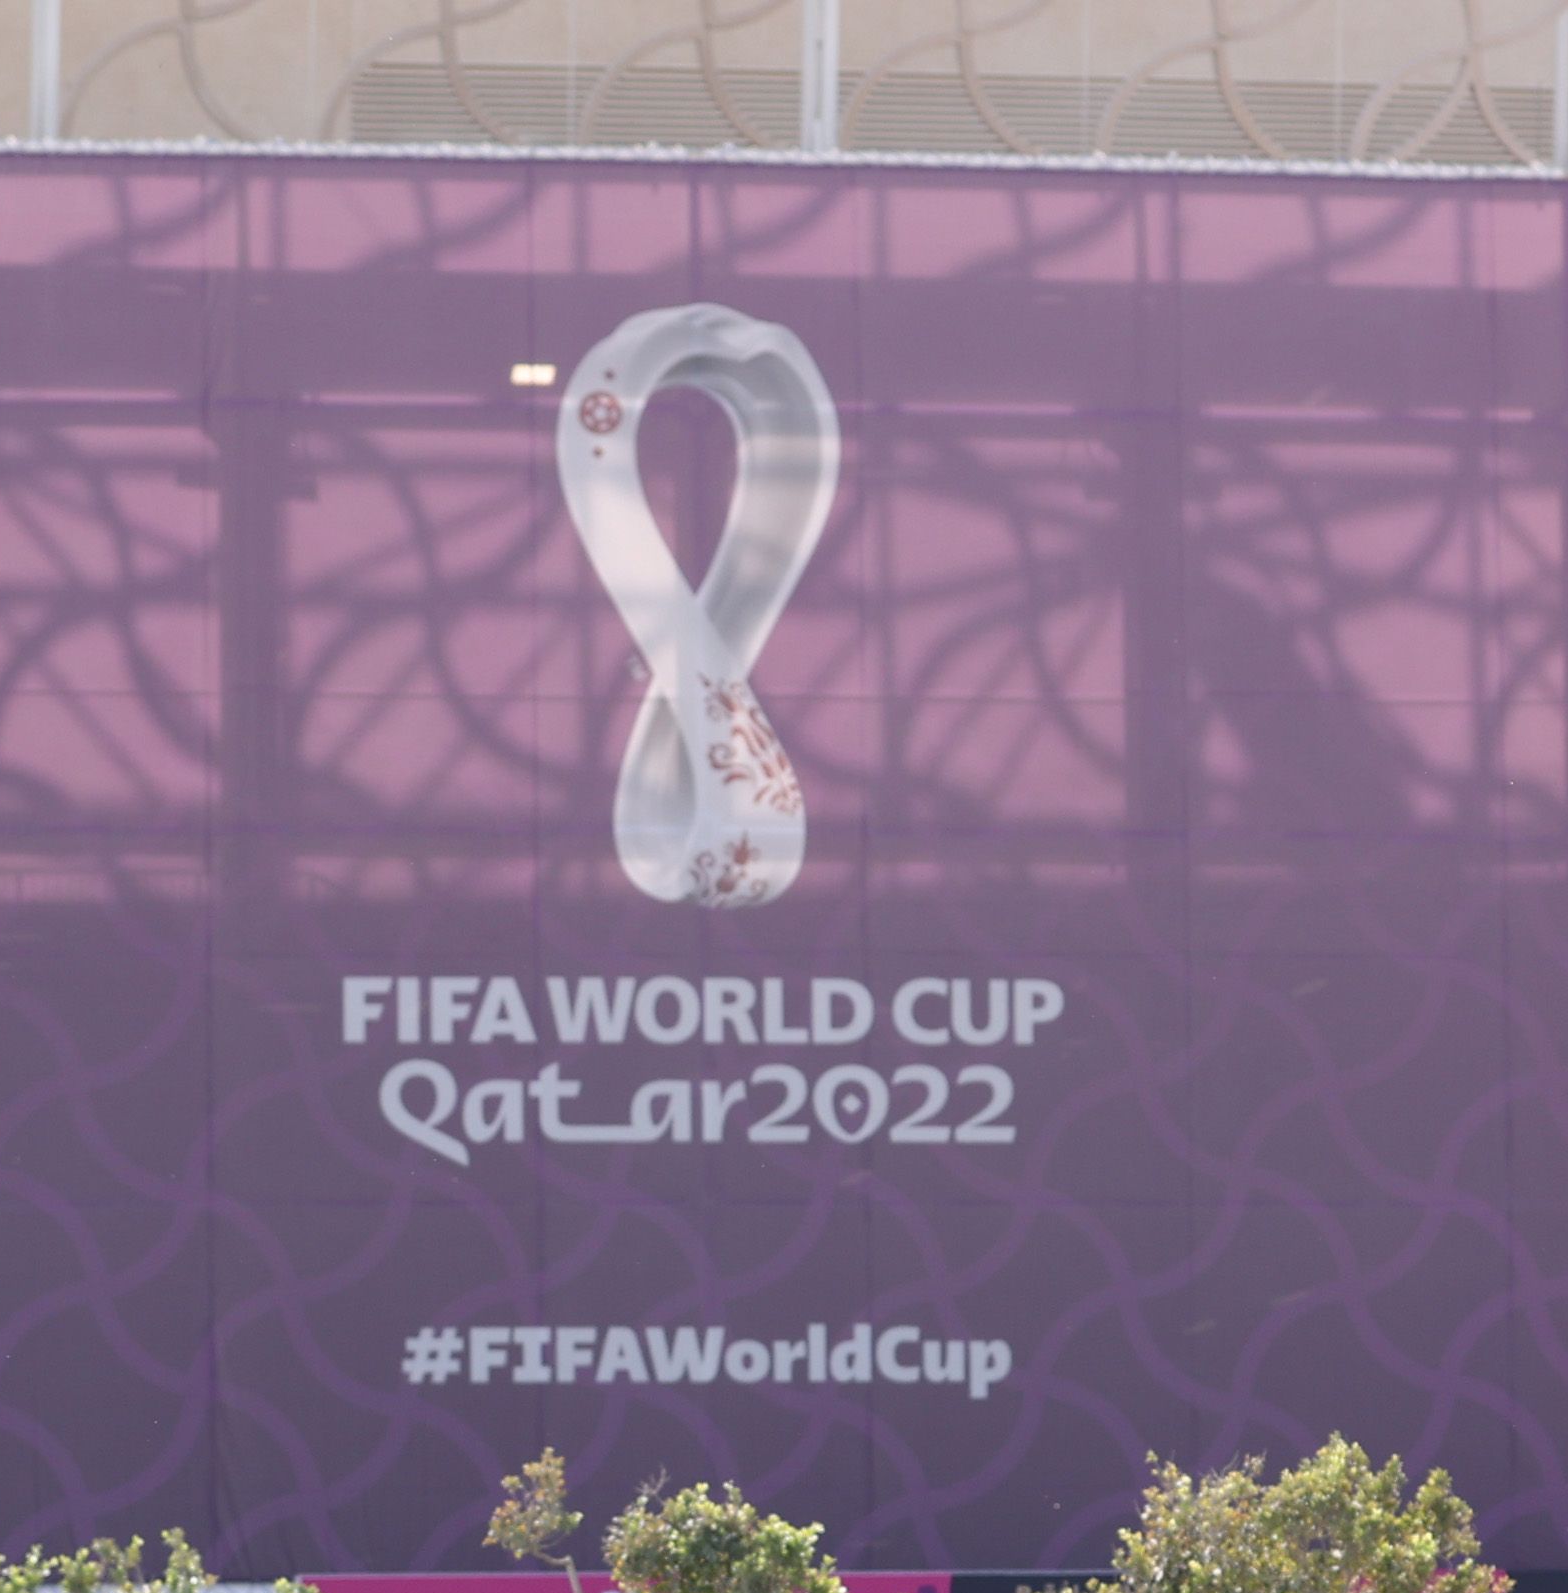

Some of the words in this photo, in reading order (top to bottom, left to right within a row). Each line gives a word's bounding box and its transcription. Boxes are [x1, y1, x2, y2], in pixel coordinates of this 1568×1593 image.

[342, 975, 537, 1044] FIFA
[545, 975, 875, 1045] WORLD
[891, 976, 1065, 1045] CUP
[401, 1322, 1012, 1400] #FIFAWorldCup
